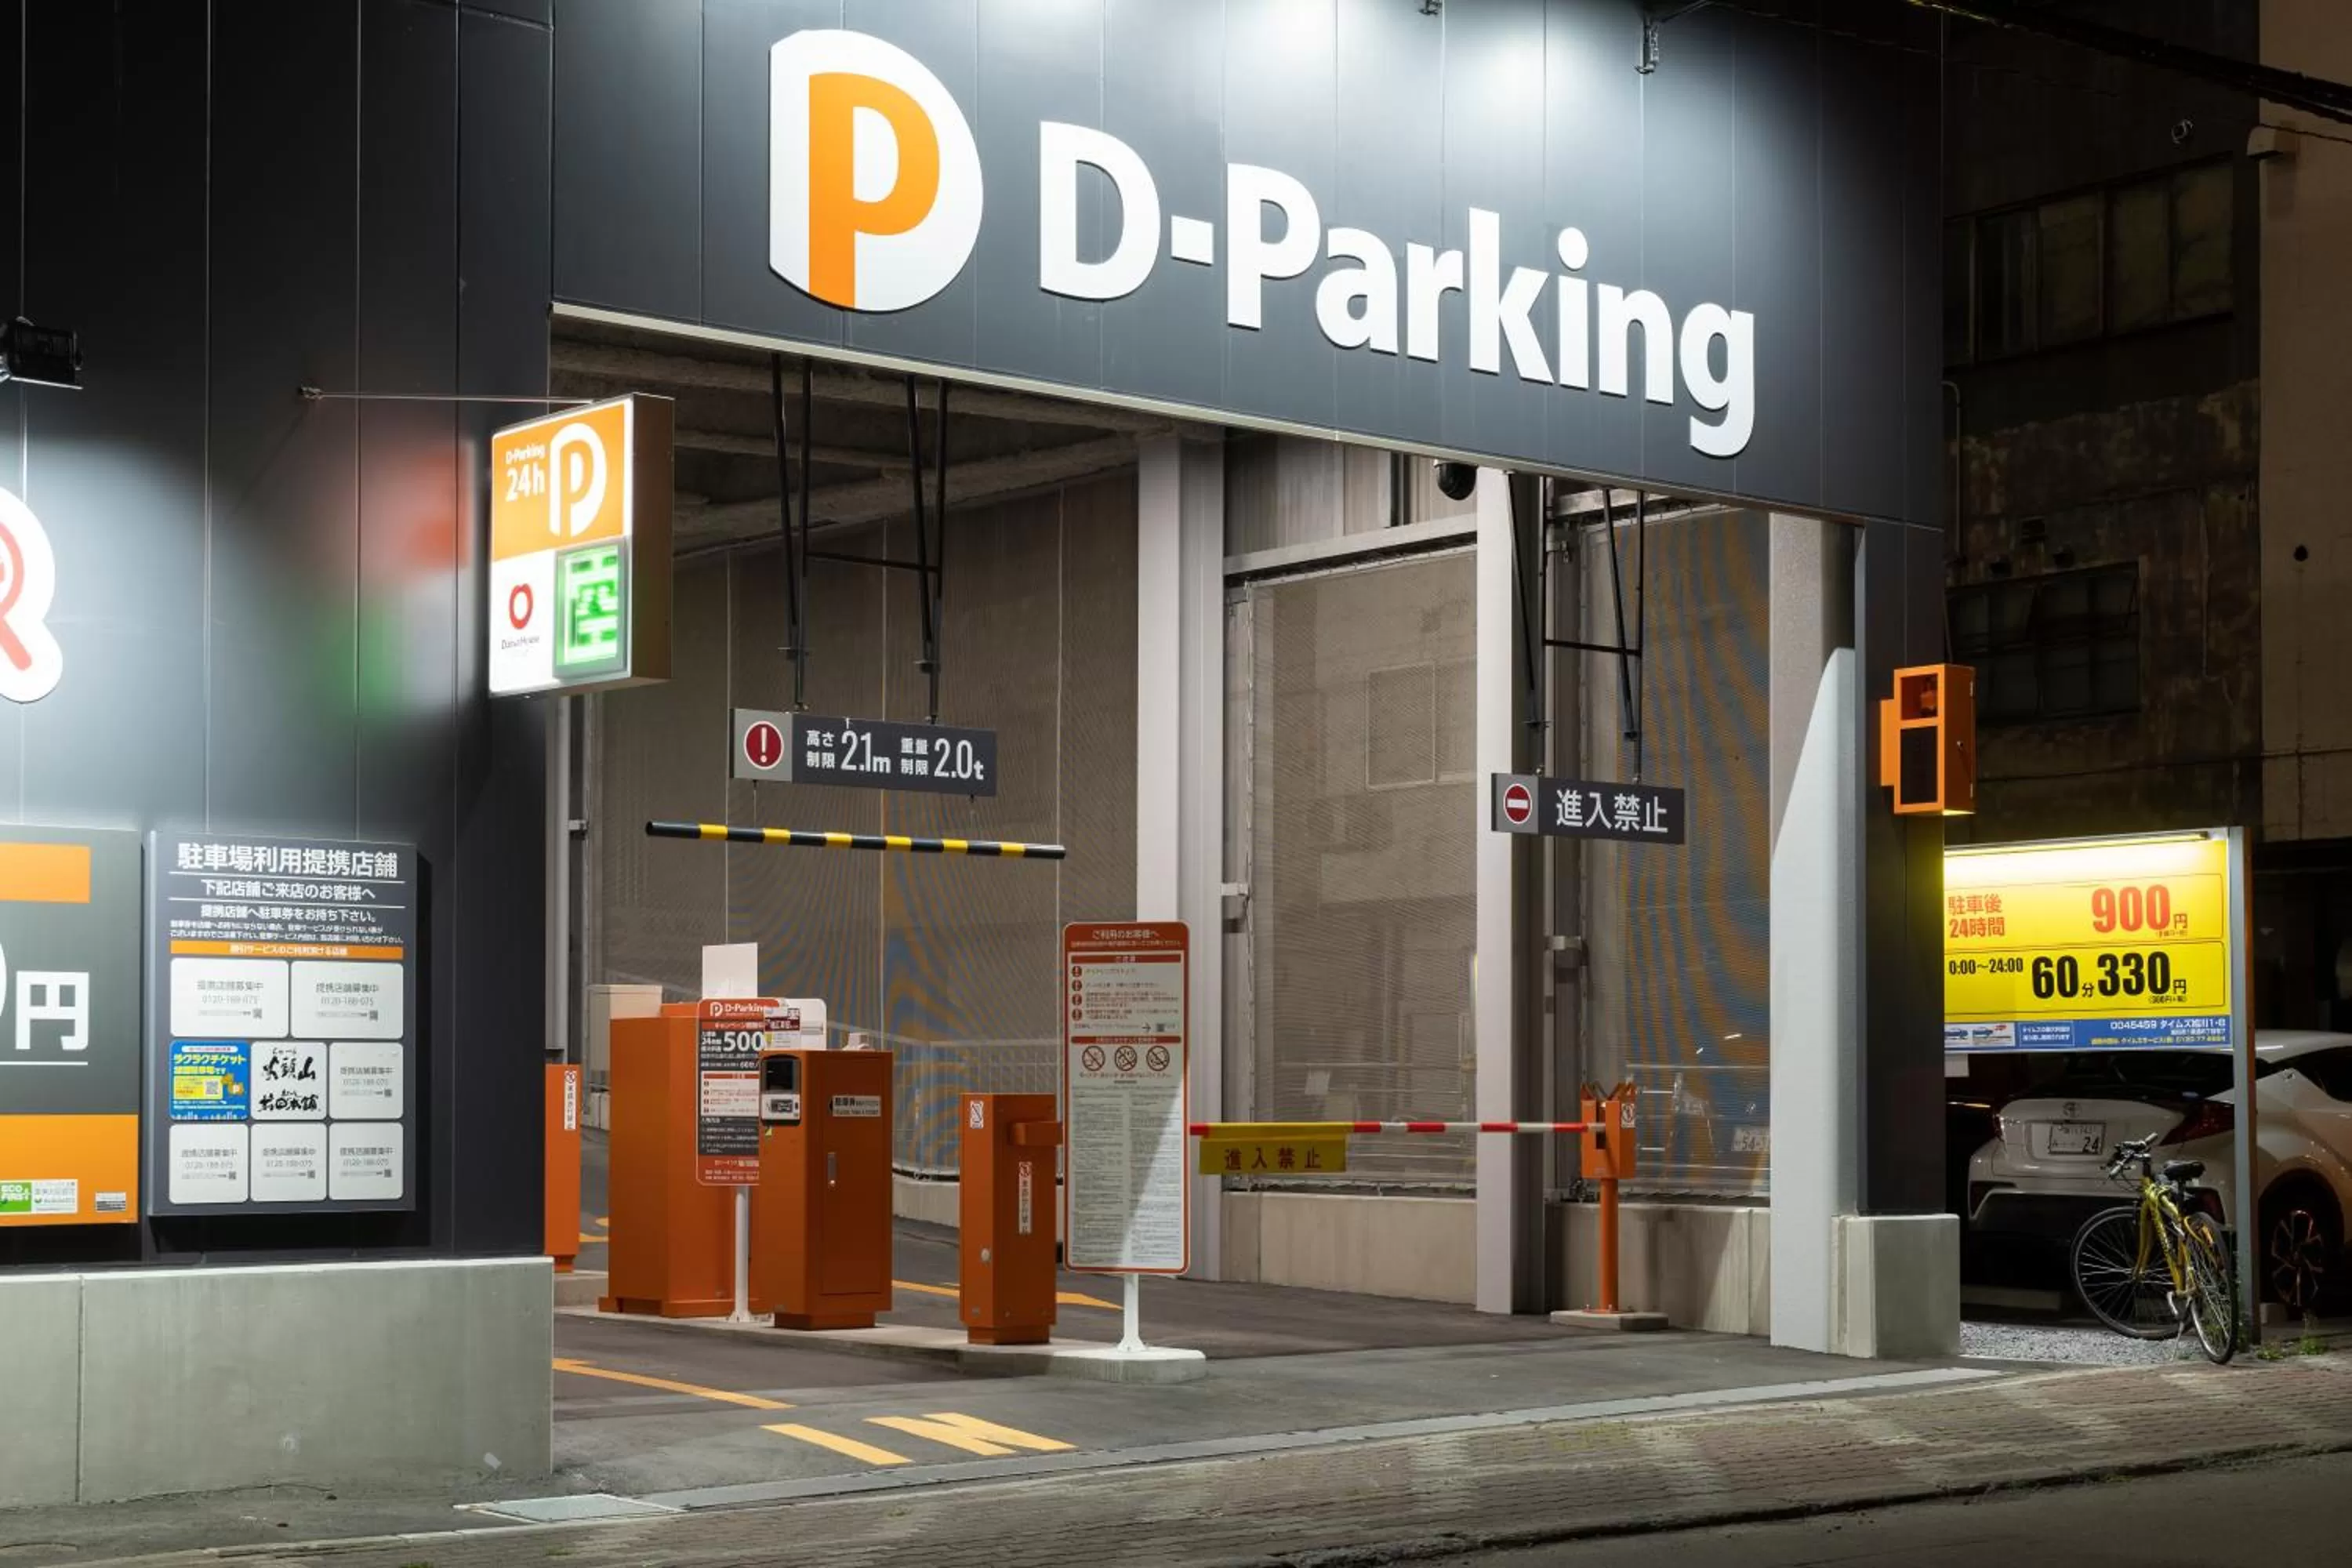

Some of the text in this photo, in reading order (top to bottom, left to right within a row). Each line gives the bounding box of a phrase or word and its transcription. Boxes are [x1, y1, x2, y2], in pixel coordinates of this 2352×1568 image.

[1040, 120, 1756, 458] D-Parking
[506, 443, 546, 466] D-Parking
[506, 463, 546, 503] 24h
[806, 730, 835, 748] 高さ
[901, 737, 928, 755] 重量
[806, 751, 835, 769] 制限
[841, 730, 891, 774] 2.1m
[935, 739, 984, 780] 2.0t
[901, 758, 928, 776] 制限
[1556, 789, 1668, 833] 進入禁止
[178, 843, 397, 878] 駐車場利用提携店舗
[201, 879, 376, 899] 下記店舗ご来店のお客様へ
[1948, 894, 2003, 916] 駐車後
[1949, 916, 2005, 938] 24時間
[0, 943, 89, 1050] 円
[723, 1031, 765, 1051] 500
[2082, 1137, 2099, 1154] 24
[1224, 1147, 1323, 1171] 進入禁止
